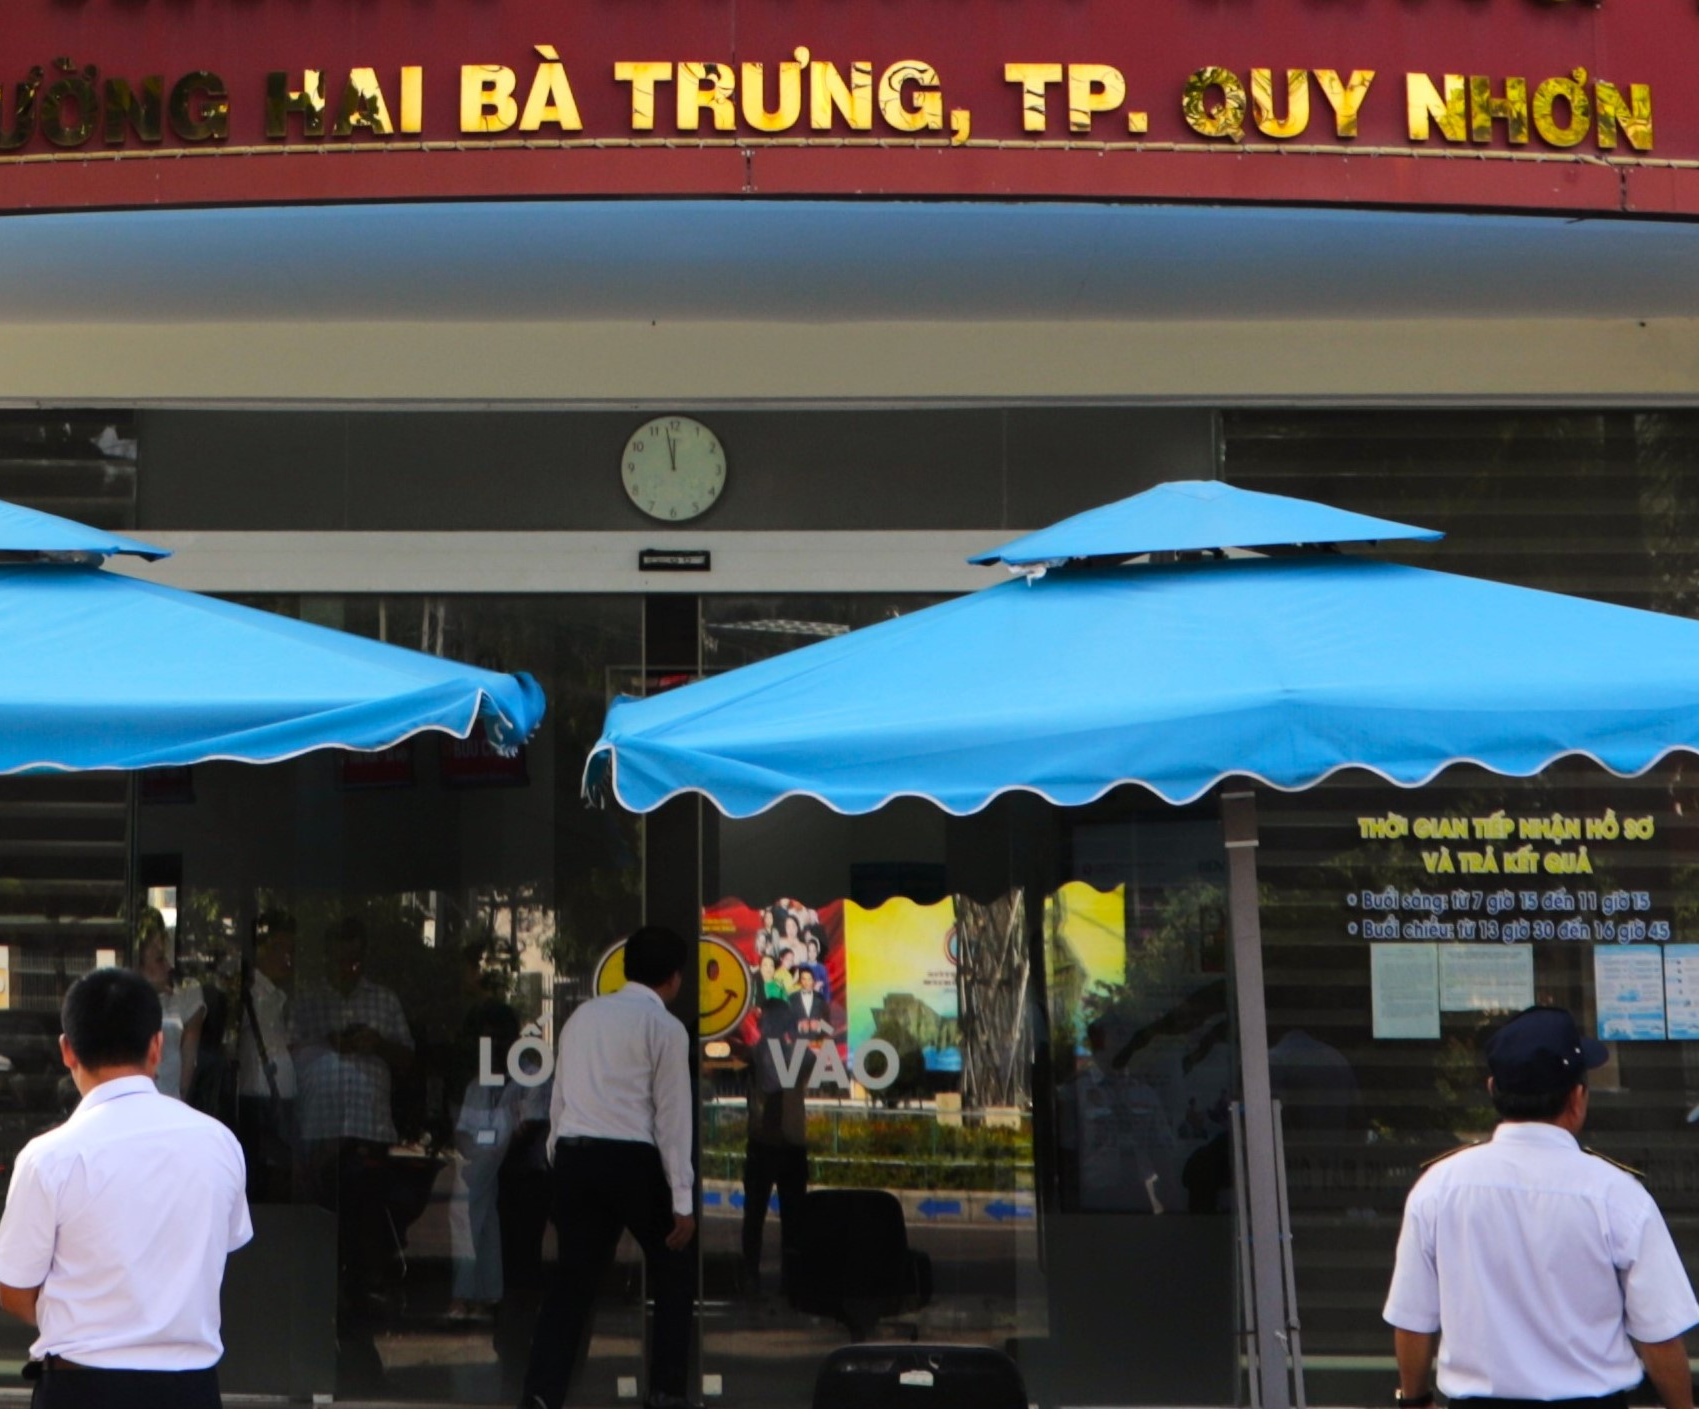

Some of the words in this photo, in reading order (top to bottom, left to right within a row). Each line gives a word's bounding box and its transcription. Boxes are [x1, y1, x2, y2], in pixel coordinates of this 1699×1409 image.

[266, 65, 424, 137] HAI
[460, 45, 583, 134] BÀ
[614, 46, 971, 147] TRƯNG,
[1003, 62, 1149, 133] TP.
[1182, 66, 1376, 144] QUY
[1405, 68, 1654, 151] NHƠN
[1357, 811, 1408, 839] THỜI
[1413, 817, 1468, 839] GIAN
[1472, 809, 1515, 839] TIẾP
[1519, 812, 1581, 844] NHẬN
[1586, 808, 1620, 840] HỒ
[1623, 815, 1654, 840] SƠ
[1422, 845, 1456, 873] VÀ
[1458, 845, 1500, 873] TRẢ
[1503, 843, 1540, 873] KẾT
[1543, 845, 1593, 874] QUẢ
[1362, 885, 1399, 909] Buổi
[1402, 888, 1448, 914] sáng:
[1451, 888, 1470, 909] từ
[1472, 890, 1483, 909] 7
[1486, 888, 1514, 914] giờ
[1519, 890, 1538, 910] 15
[1542, 887, 1575, 910] đến
[1578, 890, 1597, 910] 11
[1602, 889, 1630, 915] giờ
[1631, 890, 1651, 910] 15
[1362, 913, 1400, 938] Buổi
[1403, 914, 1454, 938] chiều:
[1457, 917, 1475, 938] từ
[1479, 920, 1500, 938] 13
[1503, 917, 1531, 944] giờ
[1533, 920, 1555, 939] 30
[1557, 916, 1591, 939] đến
[1593, 920, 1615, 939] 16
[1617, 918, 1645, 944] giờ
[1648, 921, 1670, 939] 45
[479, 1014, 554, 1087] LỐ
[768, 1020, 900, 1090] VÀO
